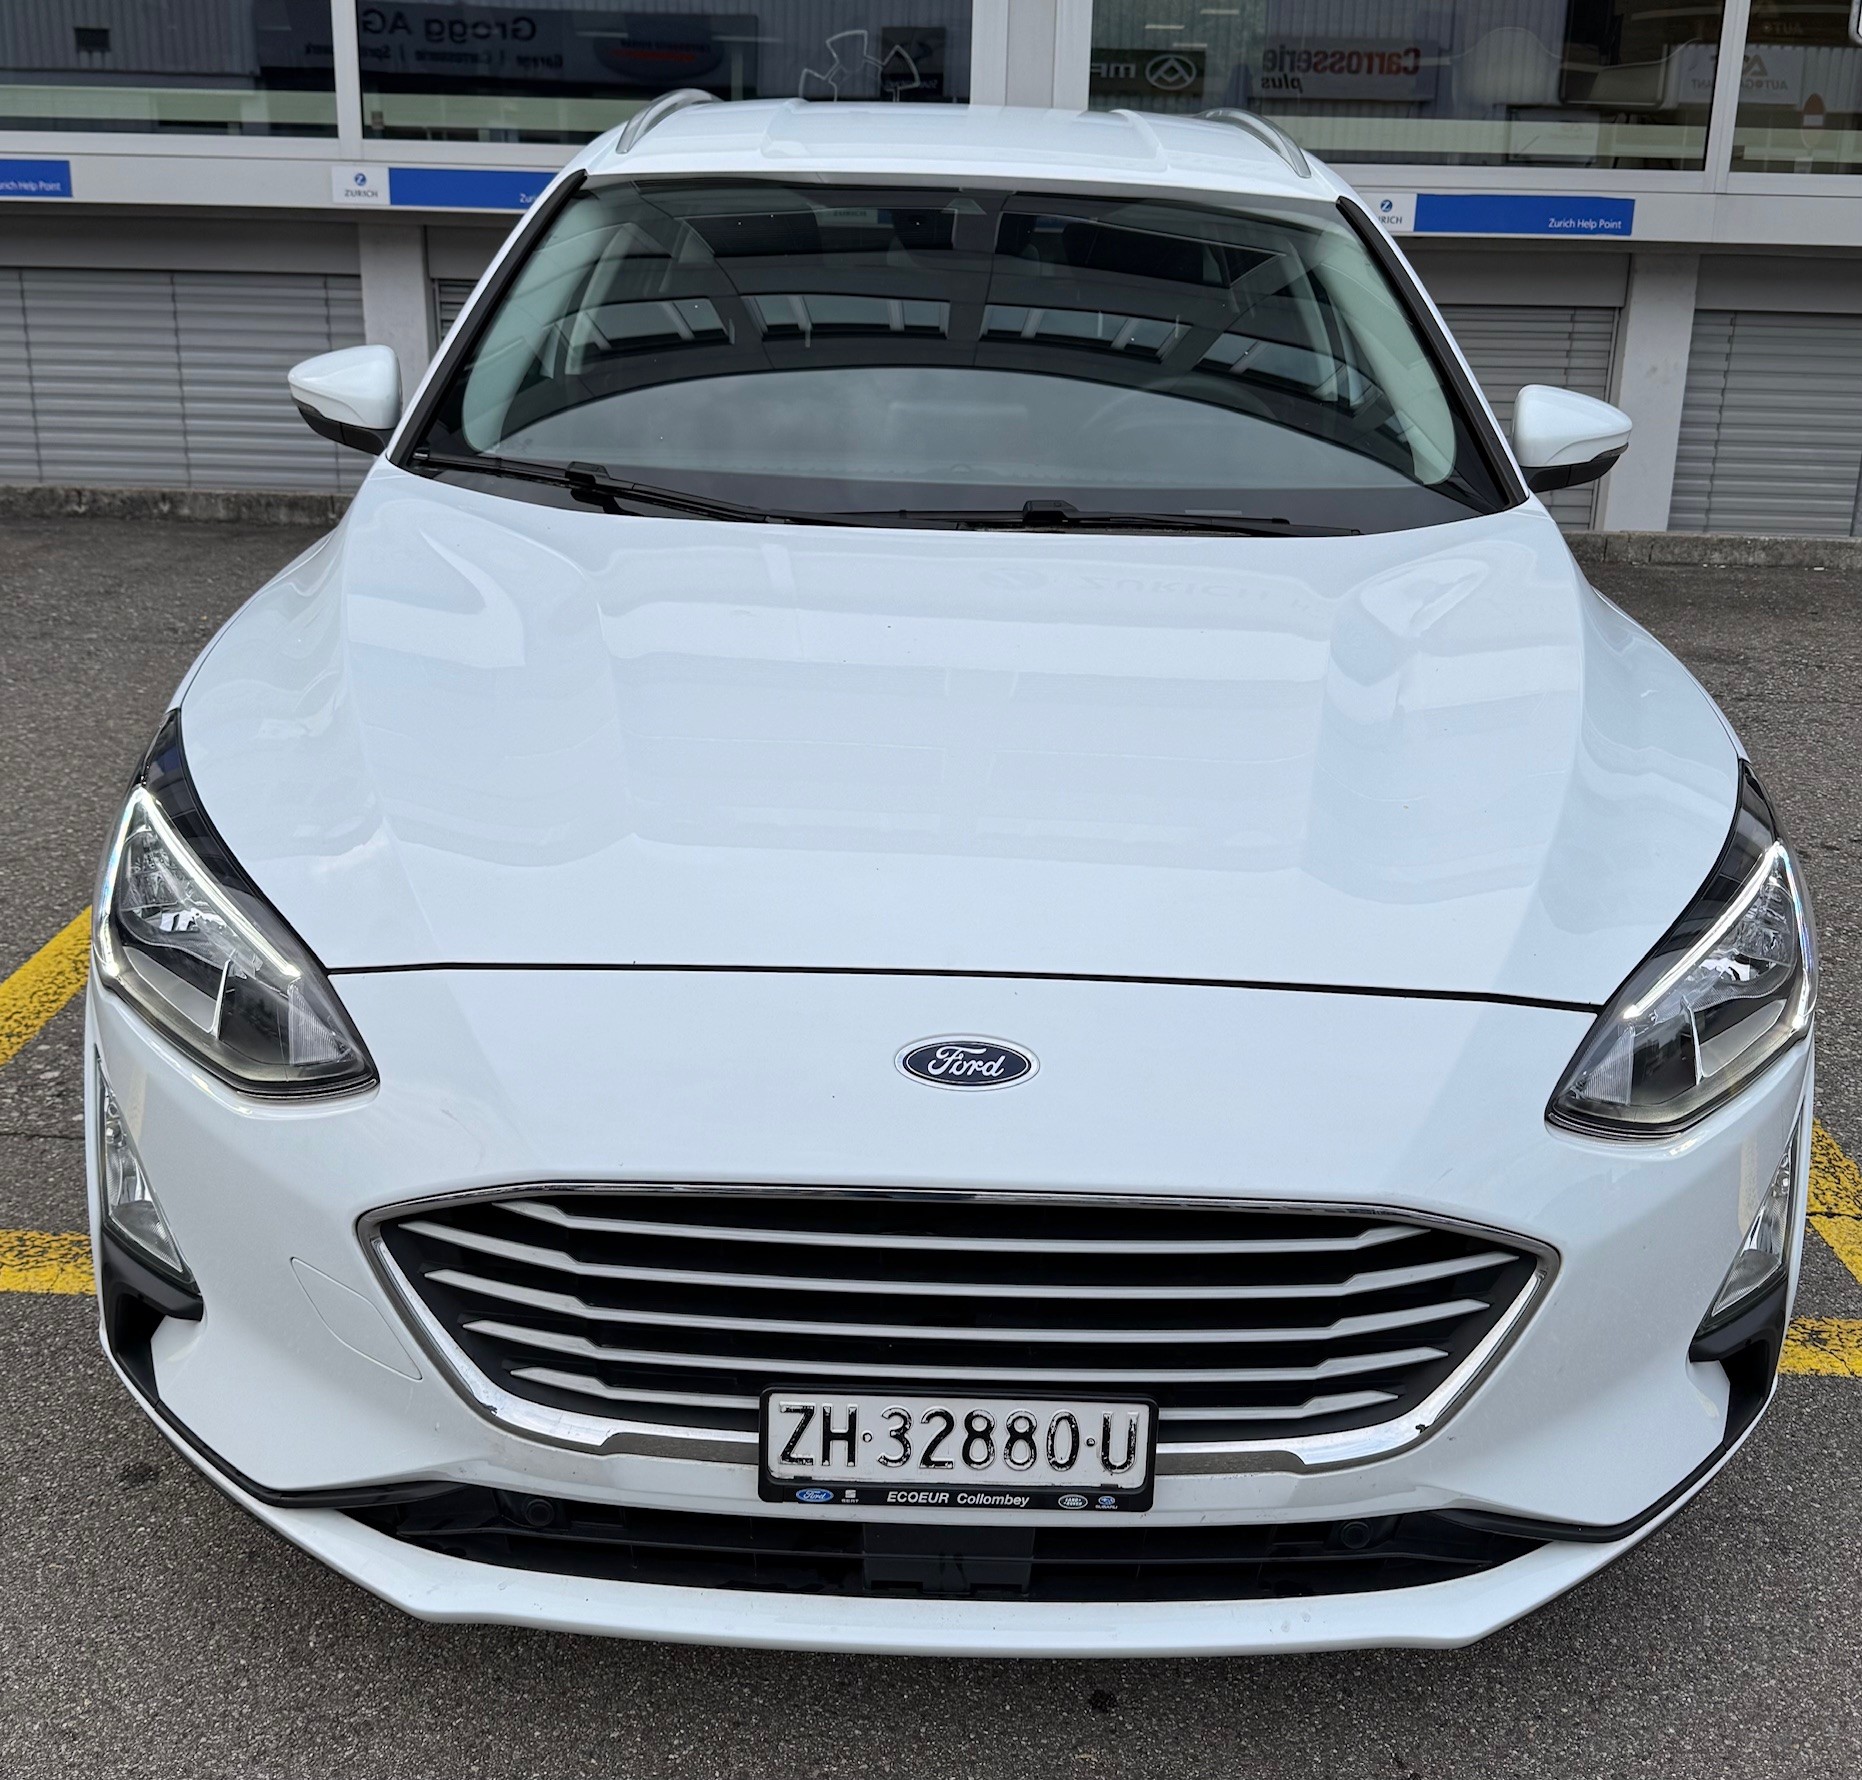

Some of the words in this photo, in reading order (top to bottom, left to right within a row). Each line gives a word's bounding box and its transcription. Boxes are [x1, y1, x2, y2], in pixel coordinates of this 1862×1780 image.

[39, 180, 61, 191] Point
[344, 189, 379, 198] ZURICH
[1379, 215, 1403, 225] RICH
[1548, 218, 1575, 229] Zurich
[1577, 218, 1598, 230] Help
[1599, 219, 1622, 229] Point
[927, 1045, 1007, 1077] Ford
[886, 1491, 950, 1504] ECOEUR
[956, 1492, 1030, 1508] Collombey
